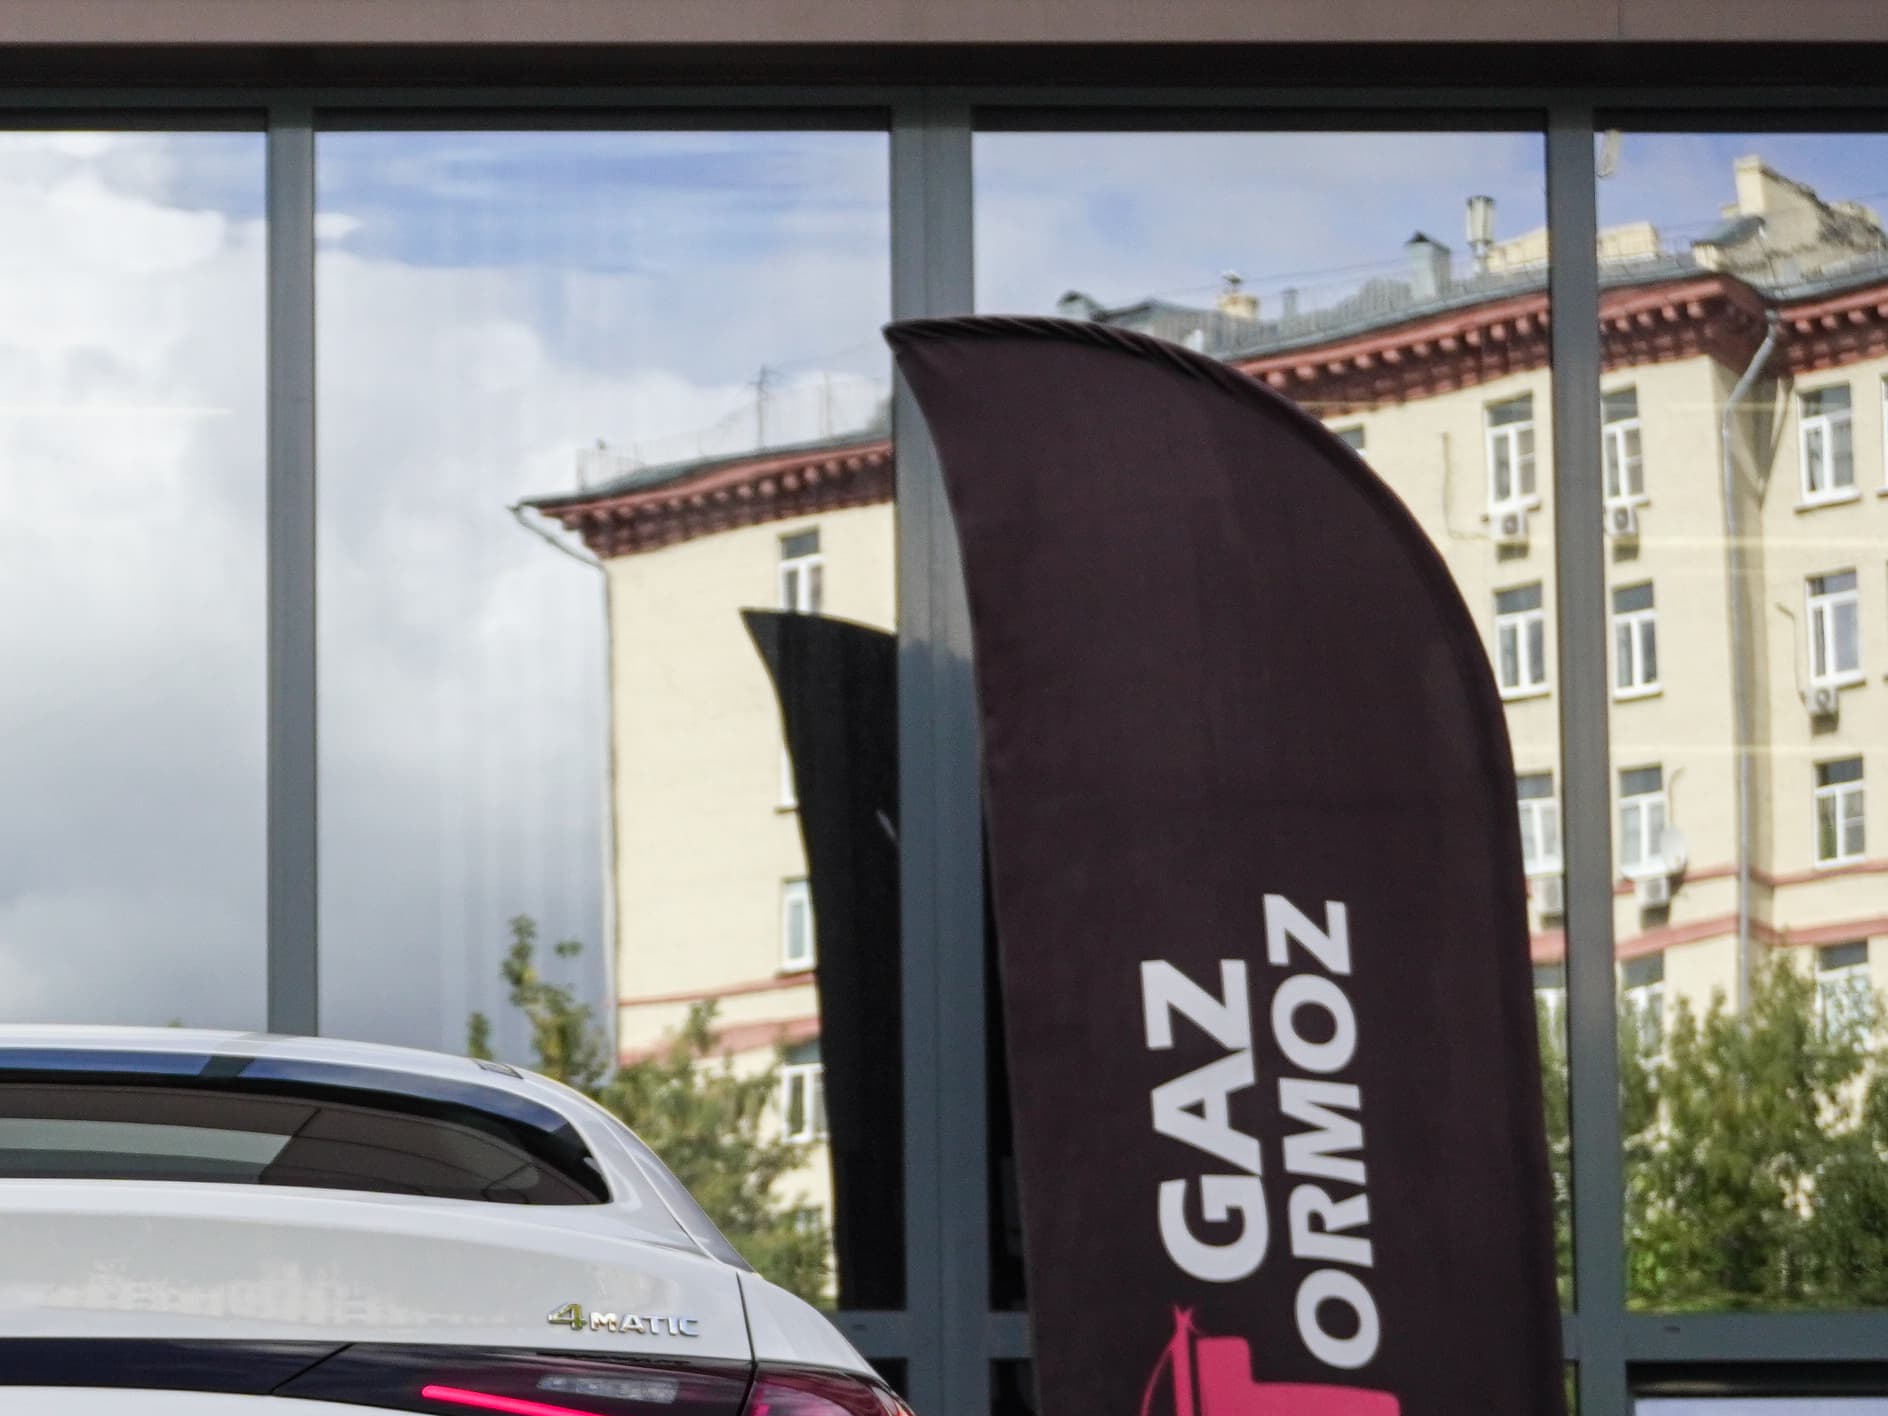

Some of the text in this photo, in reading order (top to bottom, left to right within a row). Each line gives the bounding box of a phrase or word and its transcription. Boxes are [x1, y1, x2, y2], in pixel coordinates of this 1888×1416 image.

[1140, 959, 1269, 1282] GAZ
[1263, 893, 1380, 1368] ORMOZ
[548, 1303, 700, 1337] 4MATIC
